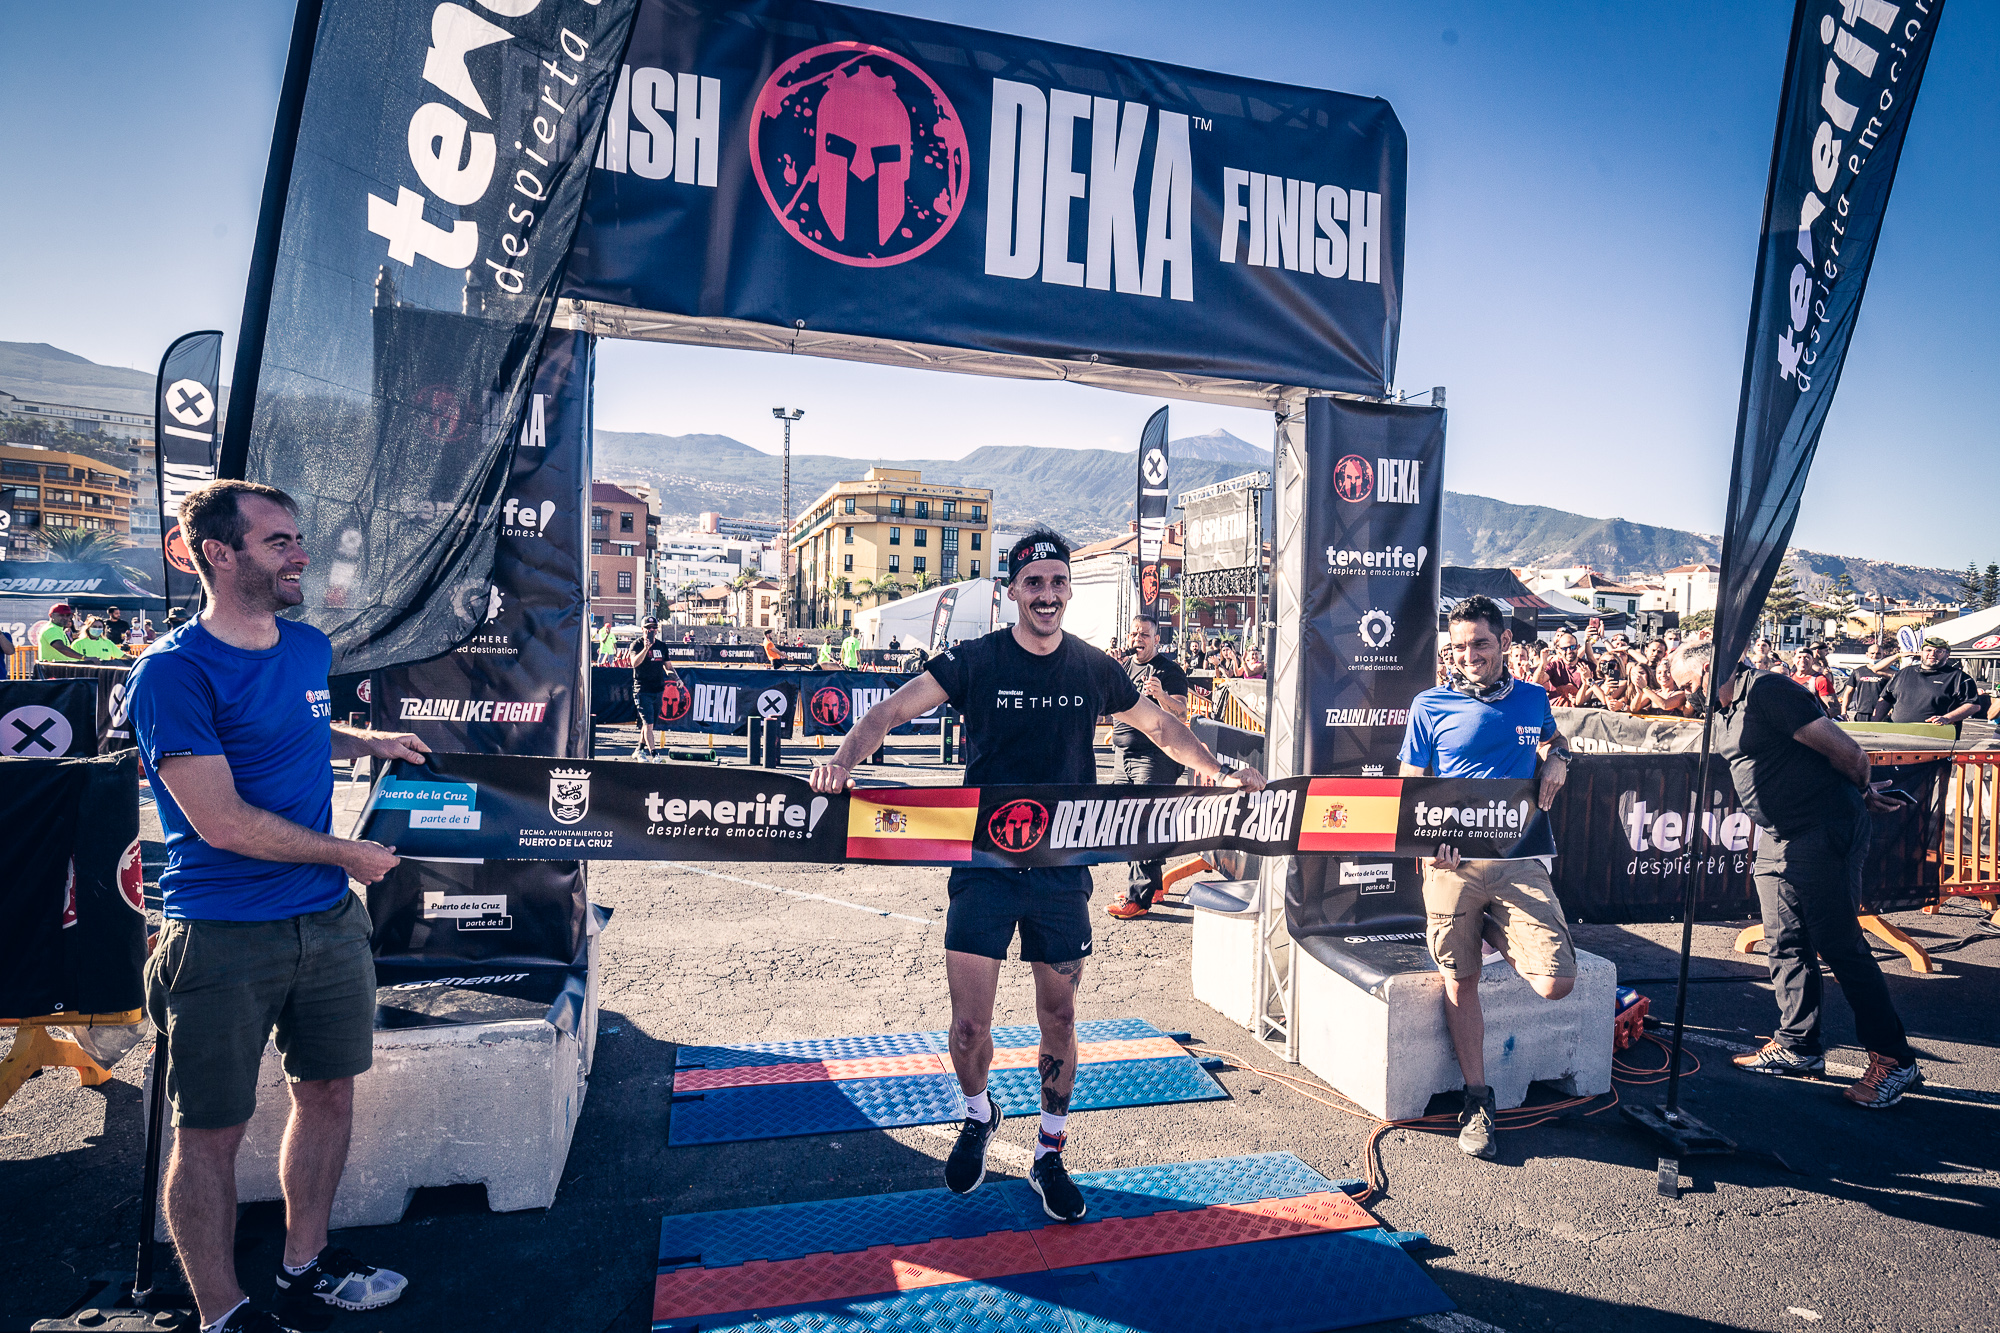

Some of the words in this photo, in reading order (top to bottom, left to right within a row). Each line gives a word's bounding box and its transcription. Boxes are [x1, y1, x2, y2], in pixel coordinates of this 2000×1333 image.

[594, 63, 720, 187] ISH
[368, 0, 540, 269] ten
[485, 27, 589, 294] despierta
[984, 78, 1194, 301] DEKA
[1778, 0, 1900, 381] tenerif
[1797, 193, 1850, 392] despierta
[1848, 0, 1935, 175] emocion
[1220, 167, 1382, 285] FINISH
[1377, 458, 1420, 504] DEKA
[502, 527, 535, 538] iones
[1202, 511, 1247, 545] SPARTAN
[1035, 542, 1057, 553] DEKA
[1032, 551, 1047, 560] 29
[1327, 566, 1366, 577] despierta
[0, 578, 102, 592] SPARTAN
[470, 645, 518, 655] destination
[728, 650, 754, 658] SPARTAN
[692, 684, 738, 724] DEKA
[996, 695, 1084, 708] METHOD
[311, 703, 331, 718] STA
[1325, 709, 1409, 727] TRAINLIKEFIG
[378, 790, 414, 801] Puerto
[416, 791, 428, 801] de
[430, 791, 440, 801] la
[443, 791, 468, 802] Cruz
[420, 814, 447, 825] parte
[449, 814, 461, 824] de
[463, 814, 470, 824] ti
[1050, 799, 1151, 849] DEKAFIT
[1148, 790, 1245, 844] TENERIFE
[1239, 789, 1298, 843] 2021
[519, 829, 547, 837] EXCMO.
[646, 822, 720, 840] despierta
[726, 827, 803, 840] emociones
[1414, 827, 1464, 839] despierta
[1468, 829, 1517, 839] emociones
[519, 838, 557, 848] PUERTO
[559, 838, 571, 848] DE
[573, 838, 585, 848] LA
[587, 838, 613, 848] CRUZ
[1375, 869, 1389, 877] Cruz
[1365, 884, 1378, 892] parte
[431, 902, 459, 911] Puerto
[461, 902, 470, 910] de
[472, 902, 480, 910] la
[481, 902, 500, 911] Cruz
[465, 919, 485, 928] parte
[487, 918, 497, 927] de
[436, 973, 530, 986] ENERVIT
